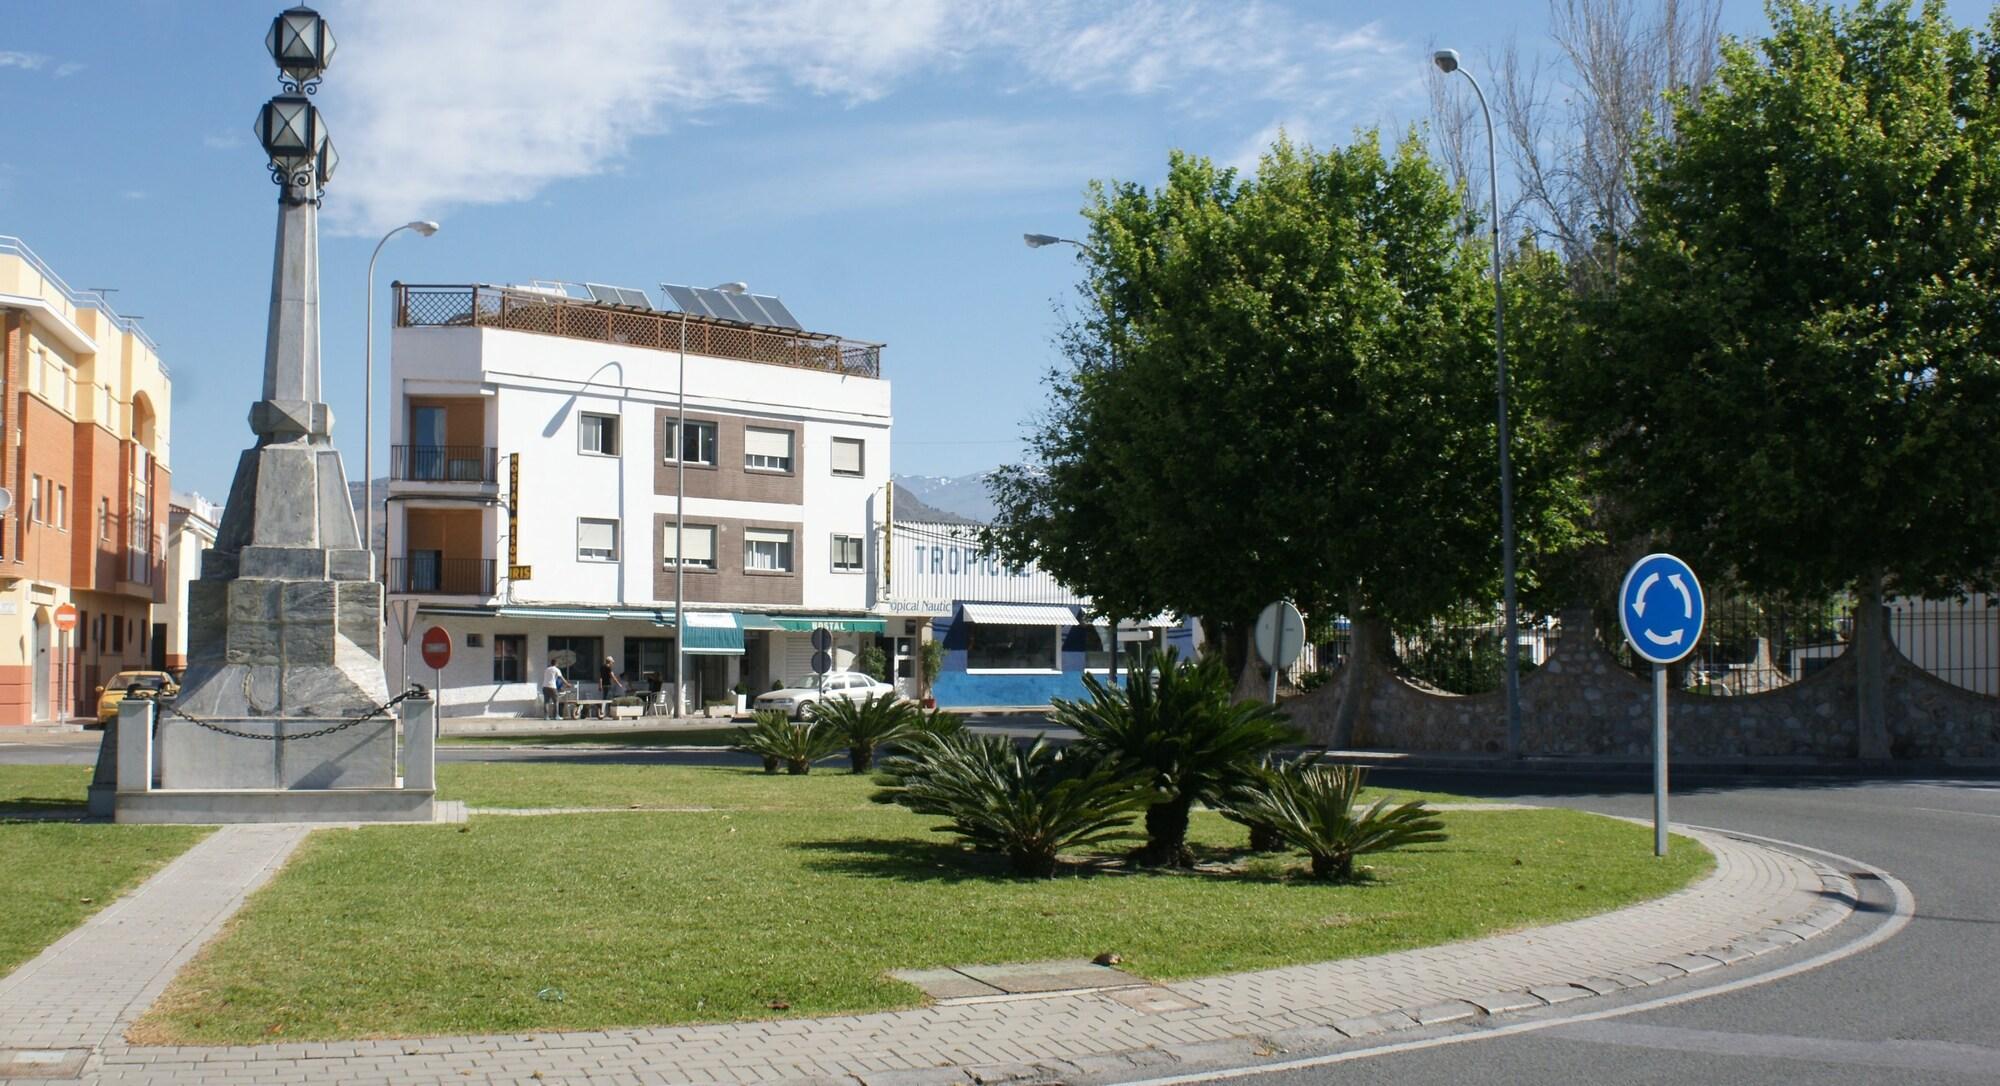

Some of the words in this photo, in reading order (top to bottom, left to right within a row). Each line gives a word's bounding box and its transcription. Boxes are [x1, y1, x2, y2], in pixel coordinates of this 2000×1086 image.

[509, 567, 531, 579] IRIS
[889, 599, 919, 613] opical
[811, 621, 846, 631] HOSTAL
